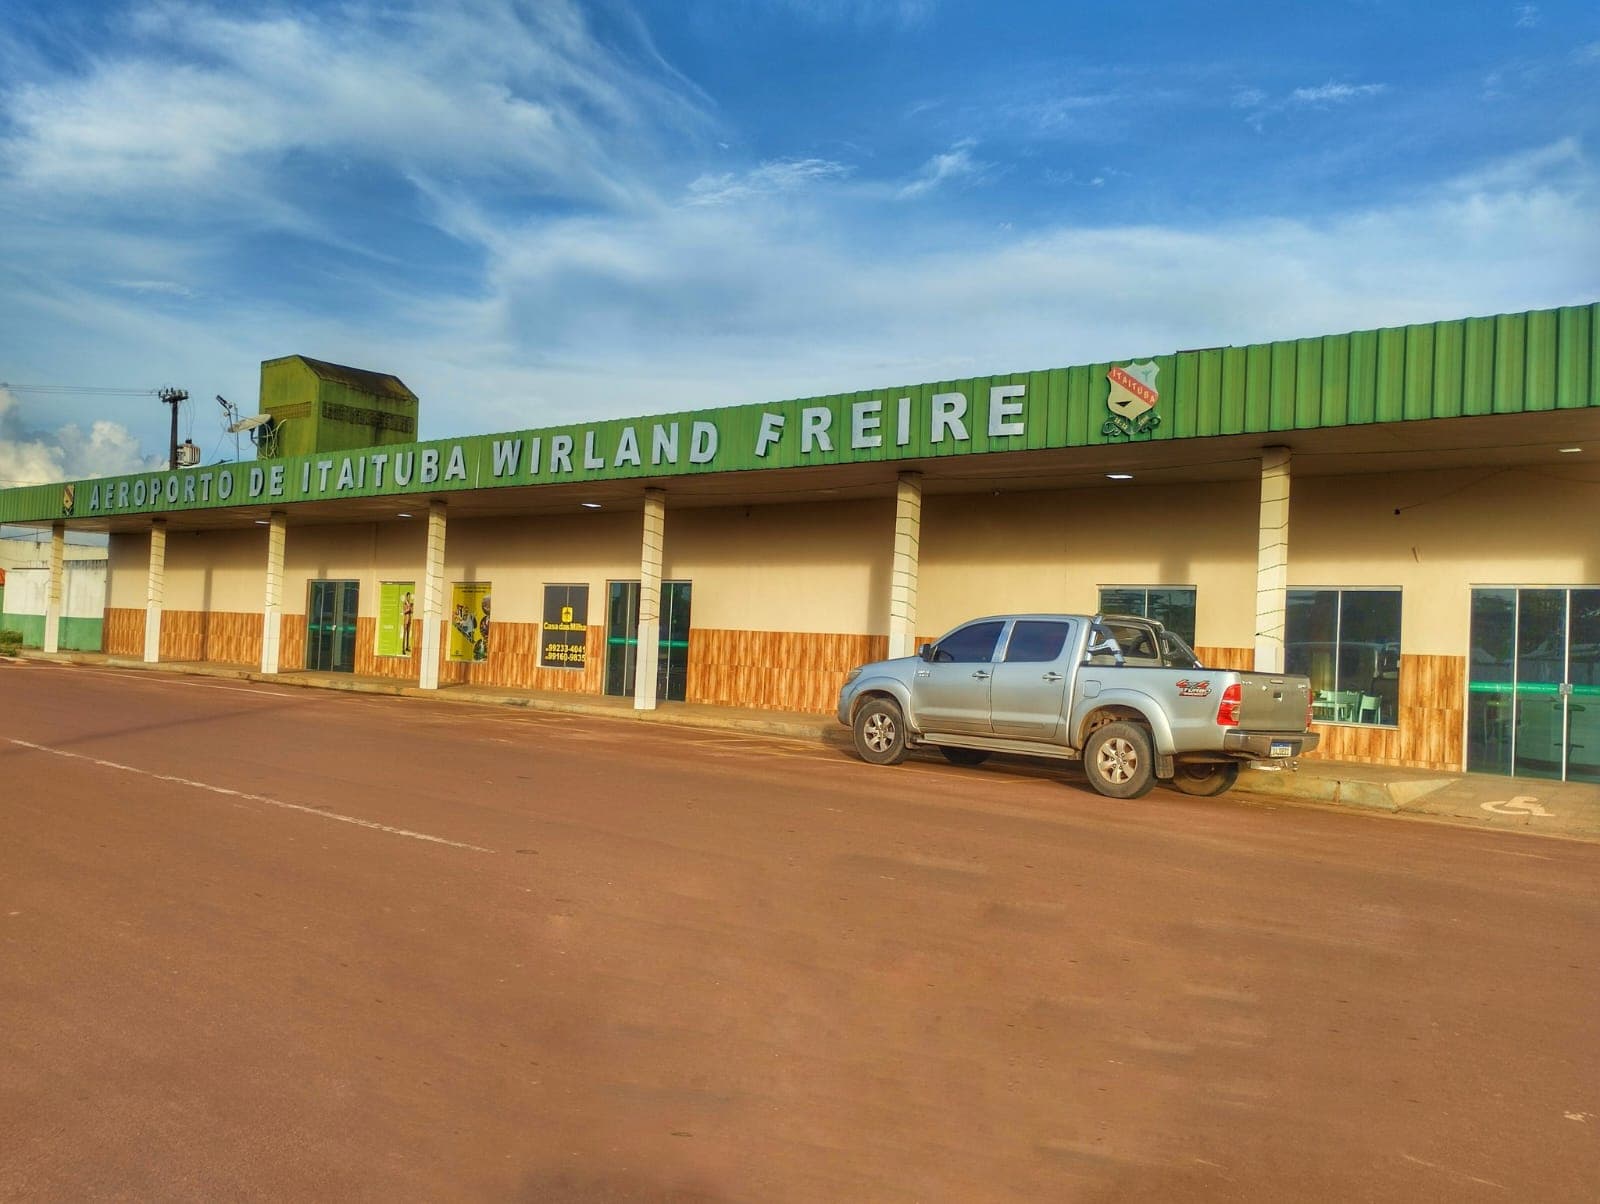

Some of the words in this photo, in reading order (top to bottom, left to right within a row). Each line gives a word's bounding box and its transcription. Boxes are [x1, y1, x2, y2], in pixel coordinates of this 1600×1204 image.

[1111, 368, 1156, 403] ITAITUBA
[90, 468, 233, 510] AEROPORTO
[249, 465, 284, 497] DE
[304, 445, 468, 492] ITAITUBA
[492, 420, 718, 478] WIRLAND
[755, 383, 1027, 457] FREIRE
[544, 621, 559, 630] Casa
